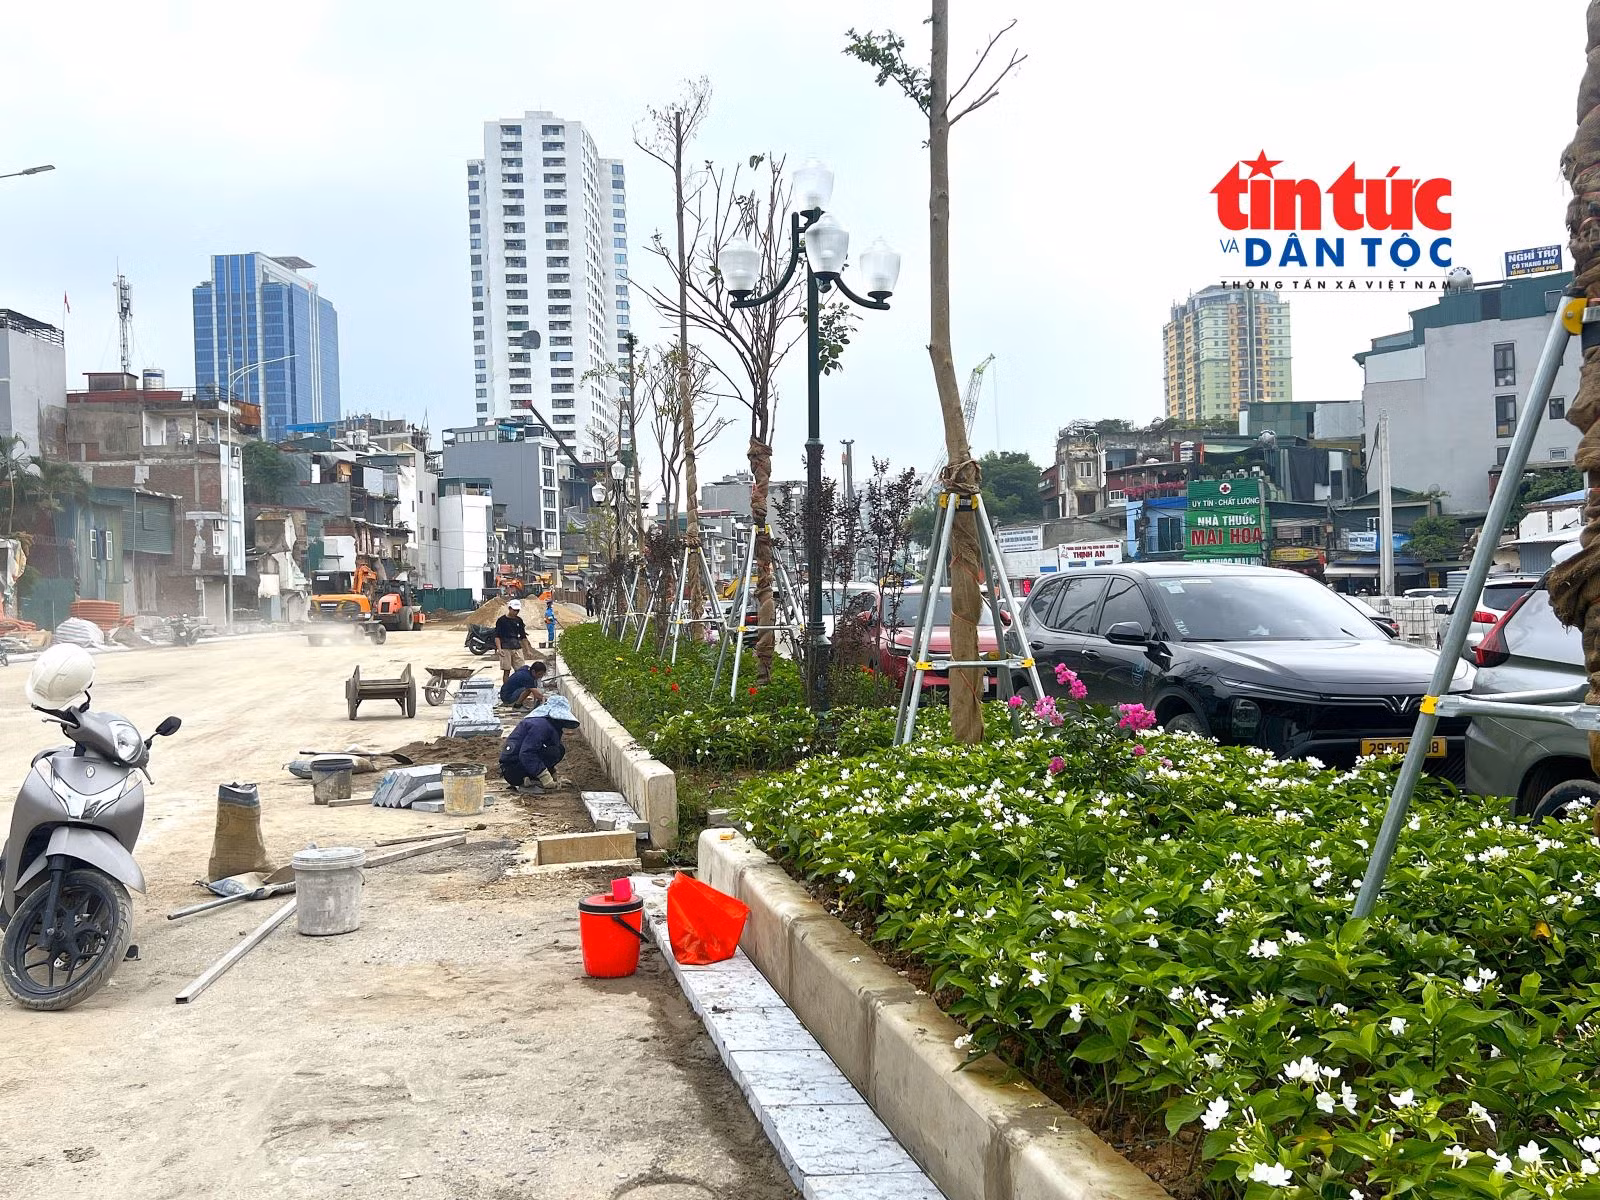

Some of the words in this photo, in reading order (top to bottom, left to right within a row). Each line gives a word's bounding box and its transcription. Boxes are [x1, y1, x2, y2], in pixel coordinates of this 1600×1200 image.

[1197, 514, 1219, 527] NHÀ
[1222, 511, 1256, 526] THUỐC
[1191, 528, 1224, 546] MAI
[1230, 527, 1263, 545] HOA
